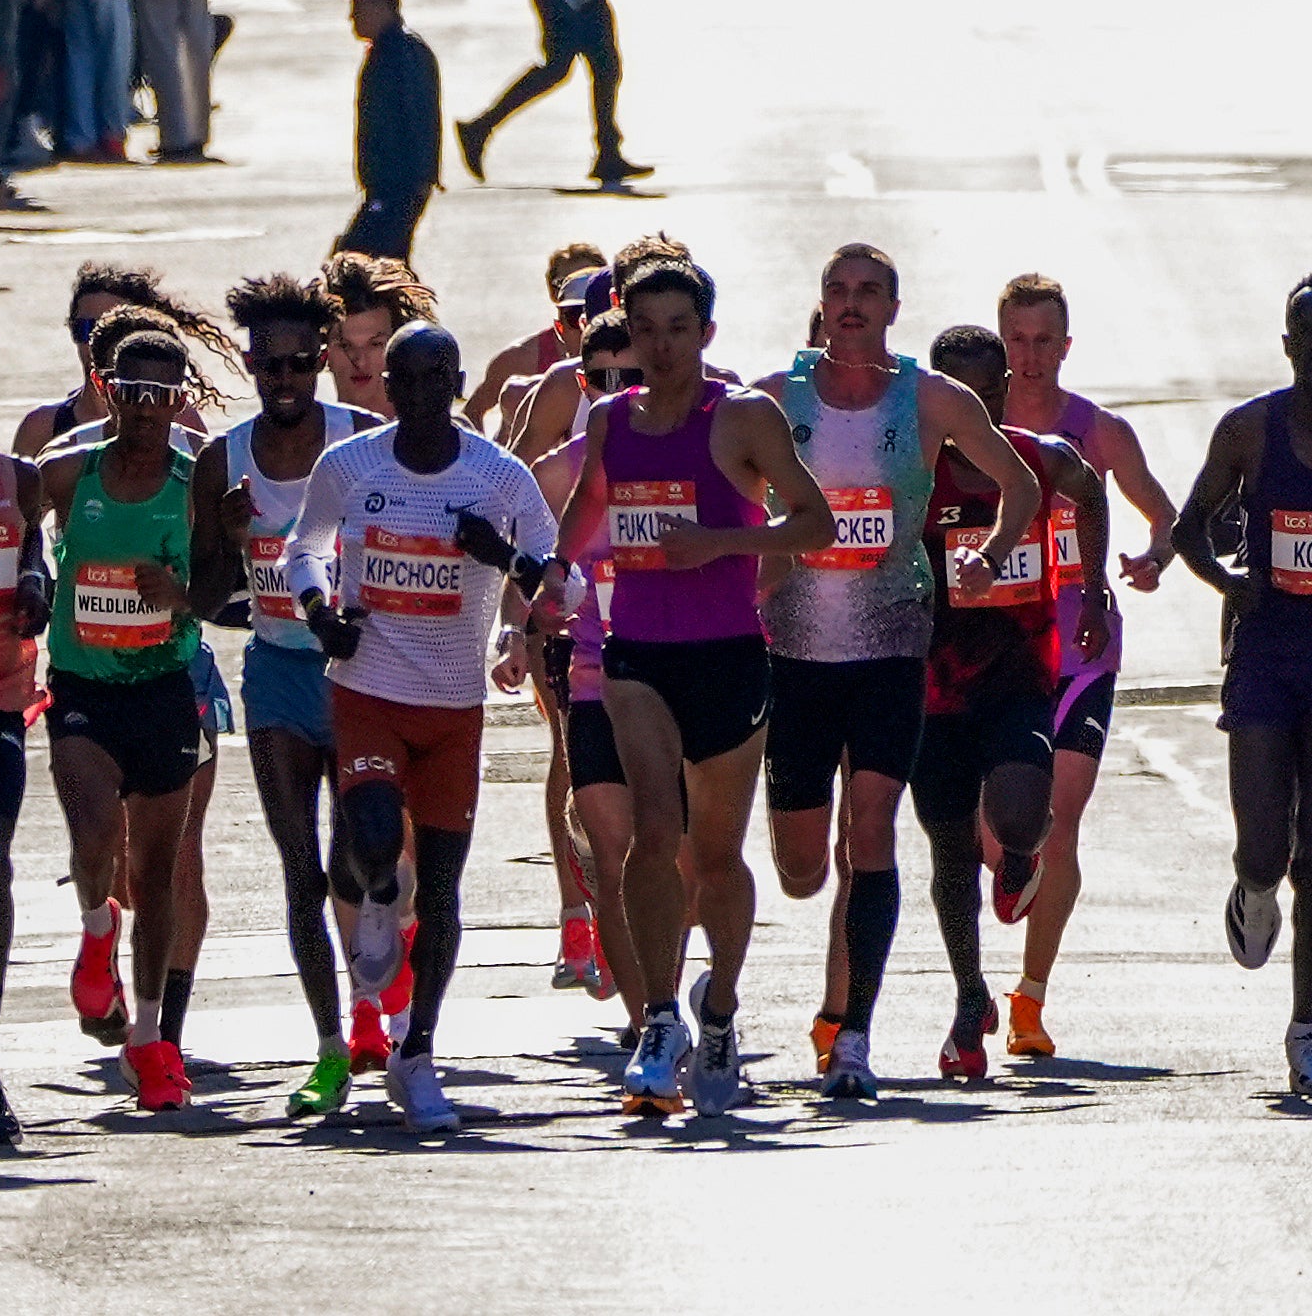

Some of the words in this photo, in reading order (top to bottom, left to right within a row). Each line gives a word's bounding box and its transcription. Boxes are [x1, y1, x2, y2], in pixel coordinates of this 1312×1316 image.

[617, 513, 682, 542] FUKU
[836, 517, 886, 545] CKER
[1284, 514, 1307, 529] tcs
[87, 566, 107, 582] tcs
[365, 555, 461, 590] KIPCHOGE
